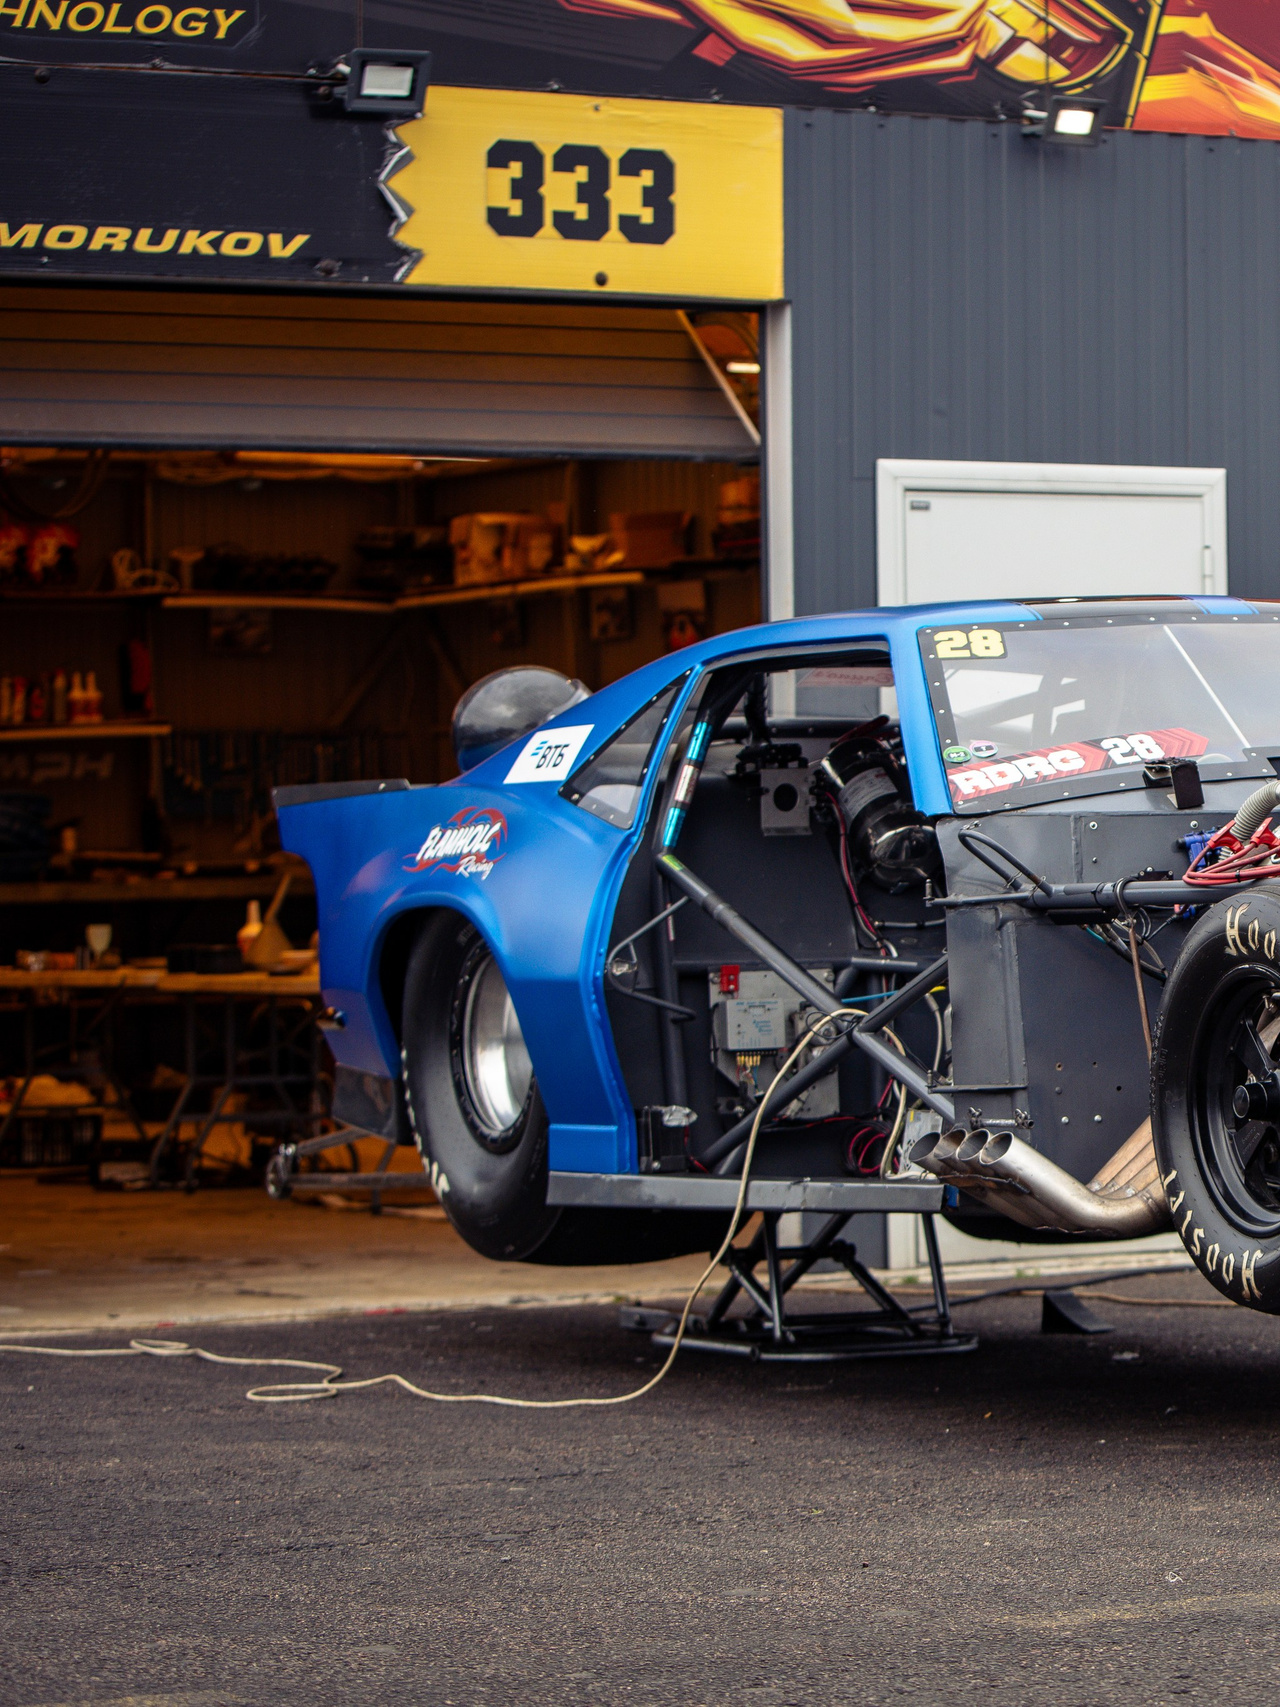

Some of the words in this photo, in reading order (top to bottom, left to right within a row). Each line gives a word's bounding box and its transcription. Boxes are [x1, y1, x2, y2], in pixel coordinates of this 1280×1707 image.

[487, 139, 675, 244] 333
[0, 222, 311, 258] MORUKOV
[933, 629, 1005, 658] 28
[535, 744, 570, 769] ВТБ
[948, 749, 1086, 795] RDRC
[1100, 733, 1165, 765] 28
[455, 855, 495, 880] Racing
